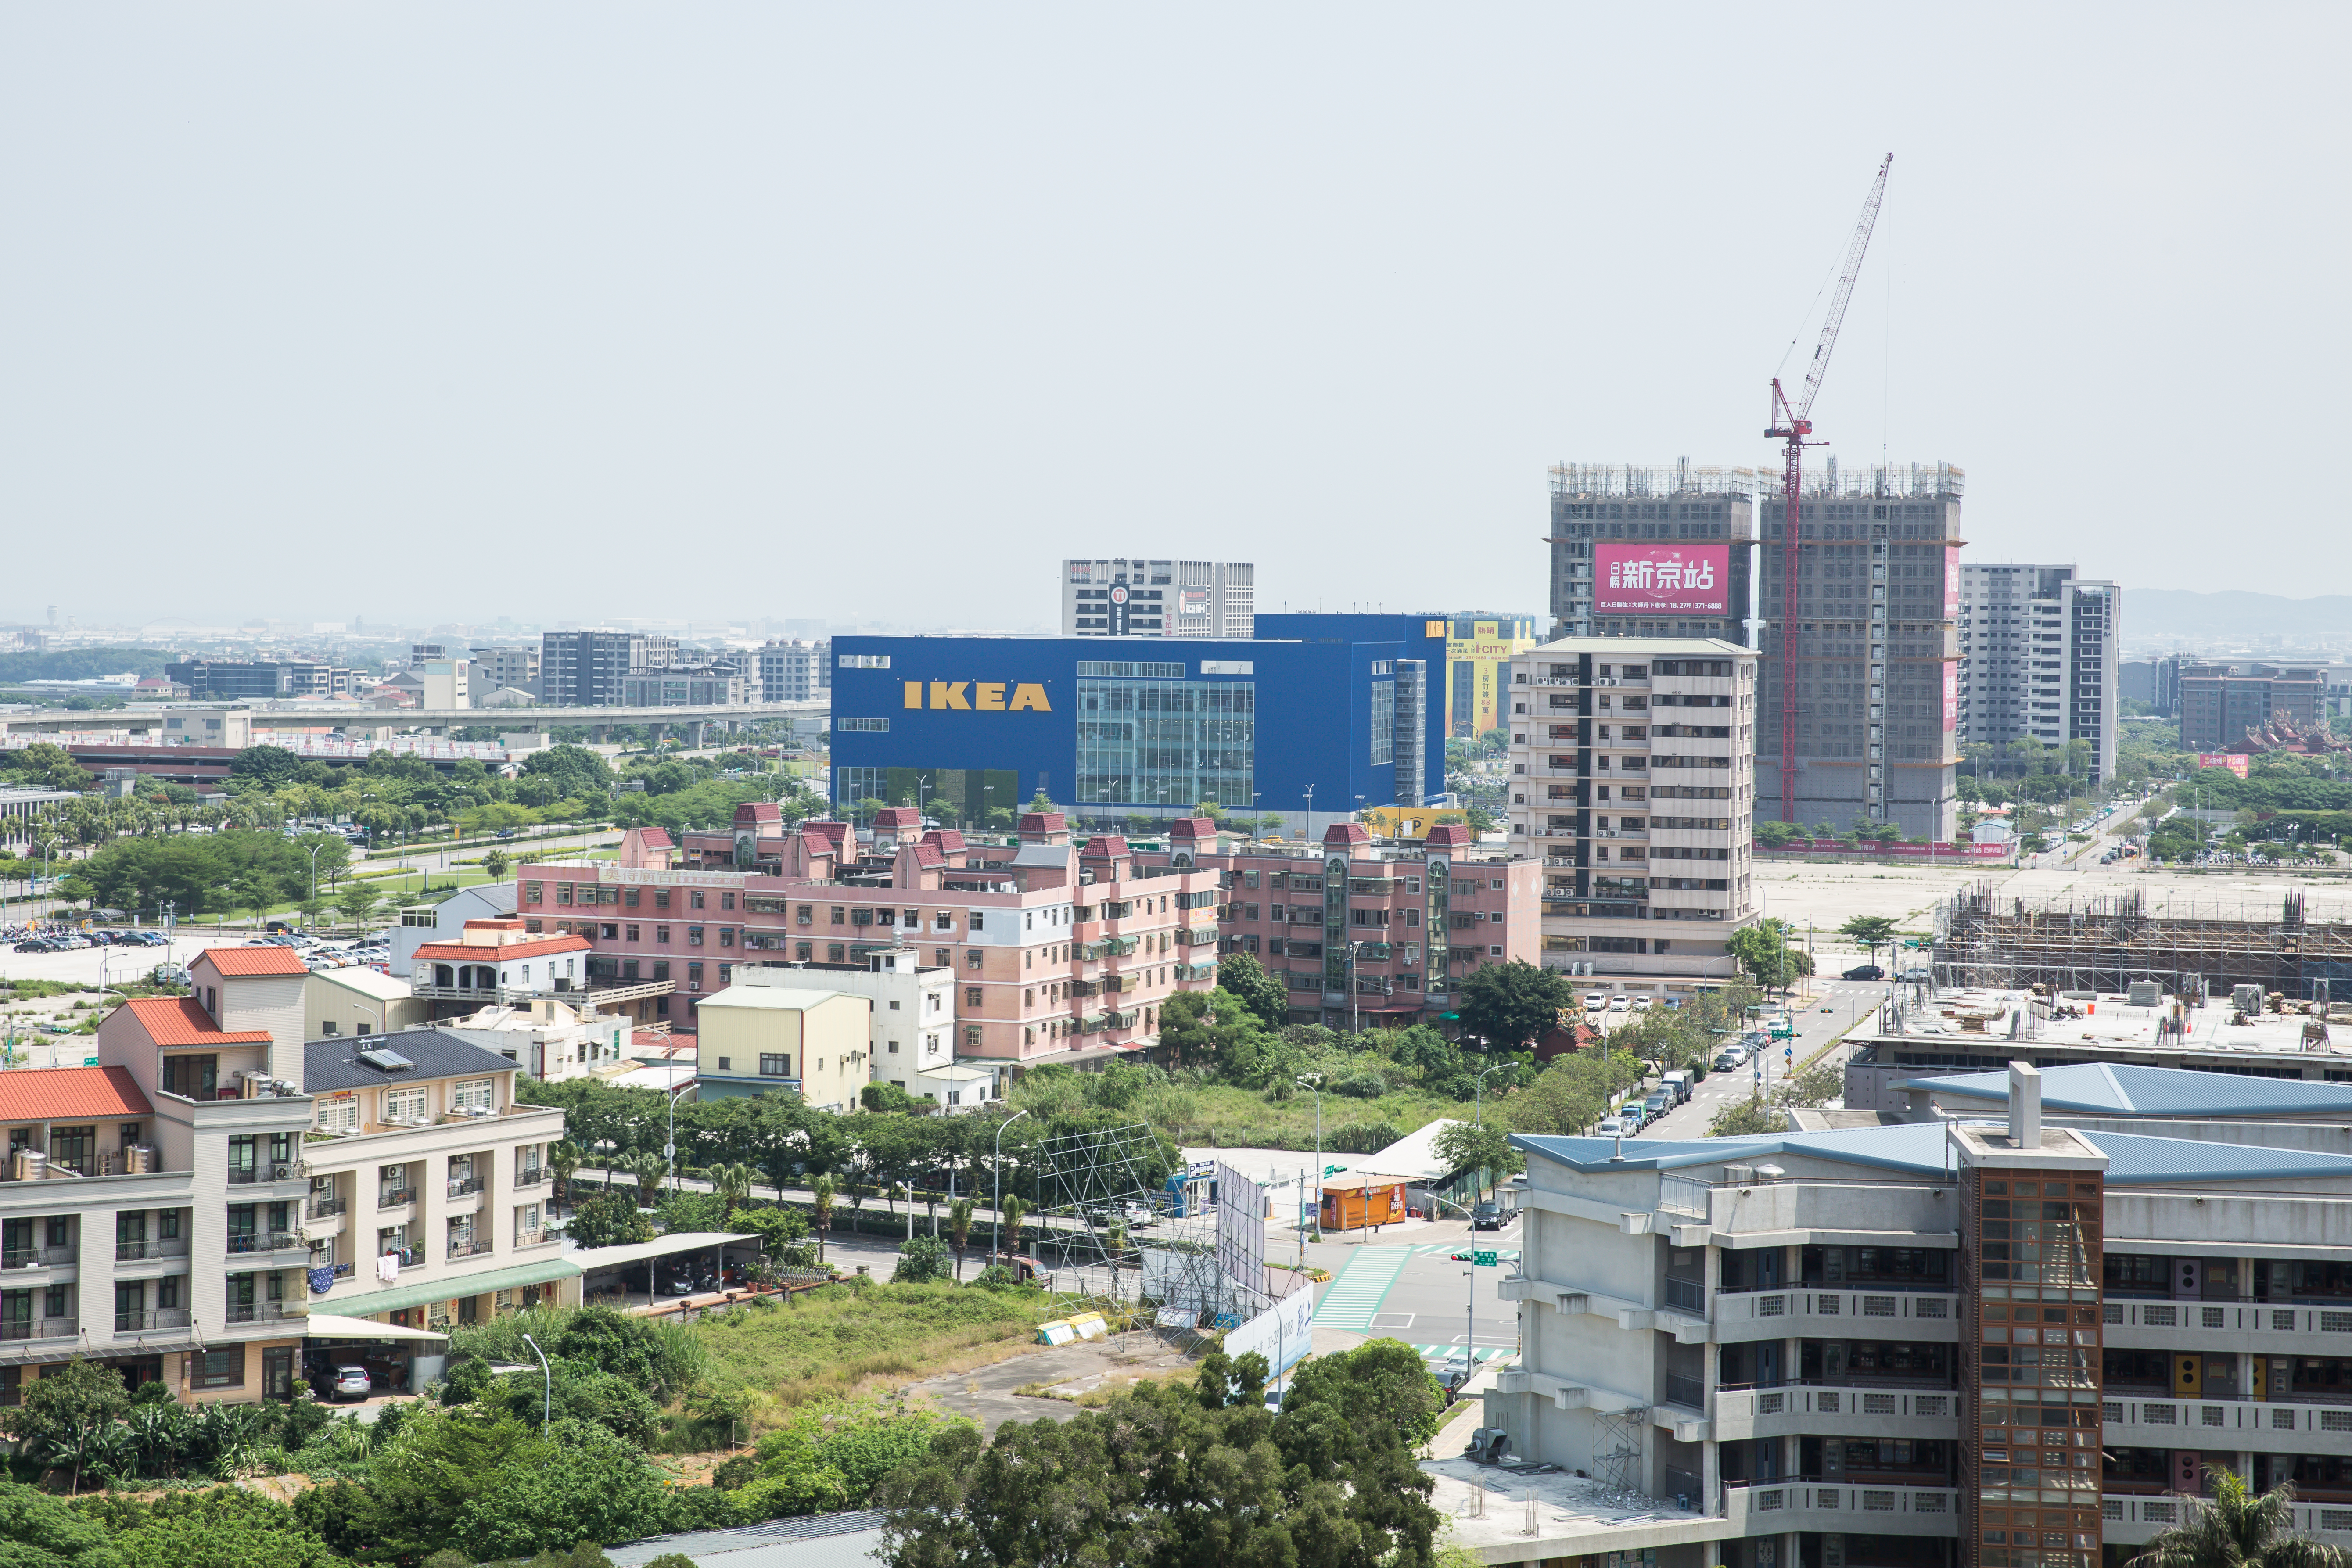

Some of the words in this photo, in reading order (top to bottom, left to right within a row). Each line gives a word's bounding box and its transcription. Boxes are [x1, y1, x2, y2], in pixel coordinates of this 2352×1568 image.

[1609, 562, 1620, 588] 日勝
[1622, 559, 1714, 590] 新京站
[1426, 621, 1445, 638] IKEA
[904, 681, 1052, 711] IKEA
[1413, 820, 1422, 832] P
[1190, 1165, 1195, 1176] P
[1267, 1319, 1293, 1349] 03-28-1888
